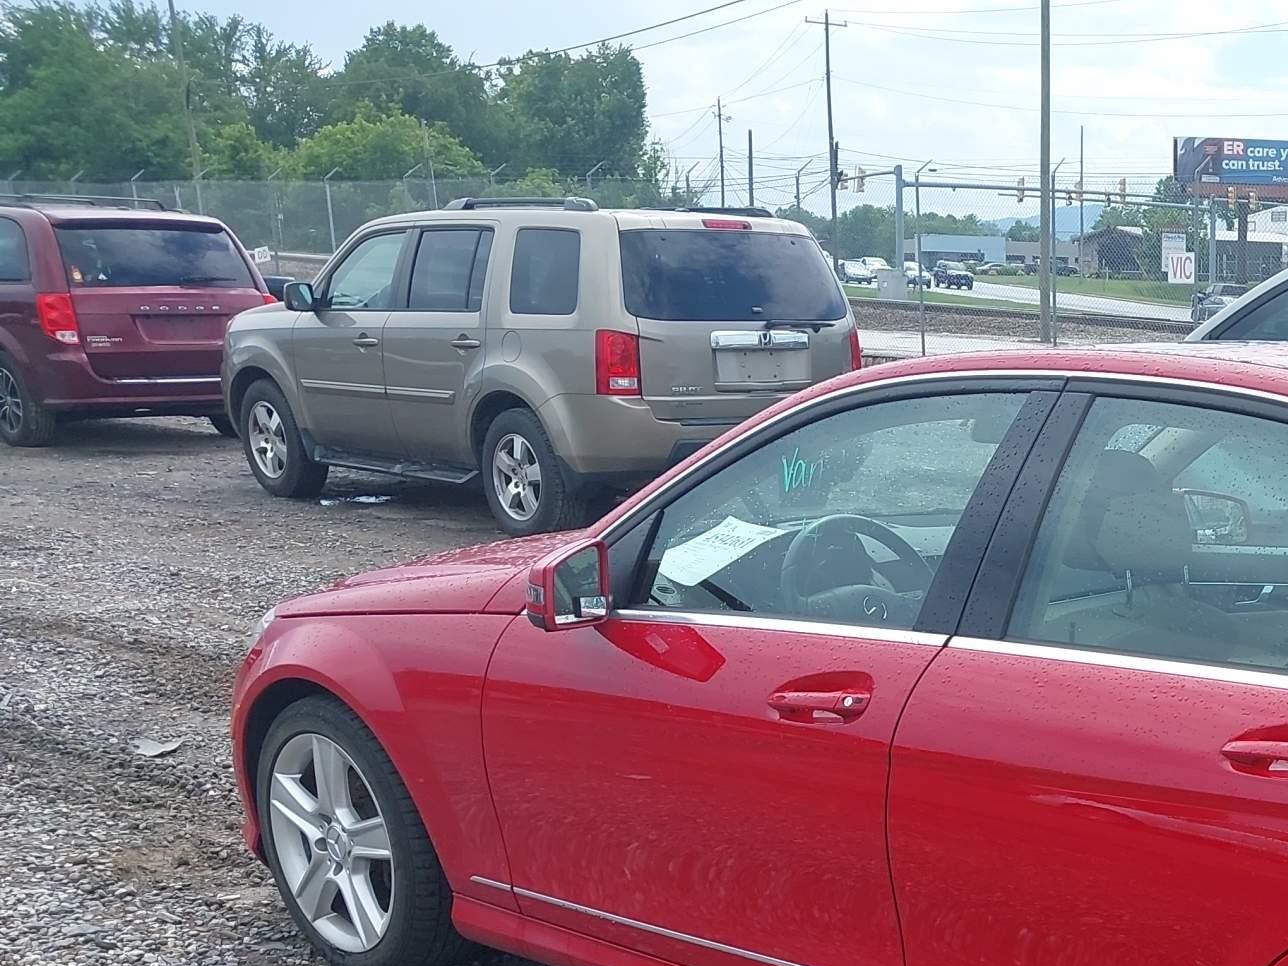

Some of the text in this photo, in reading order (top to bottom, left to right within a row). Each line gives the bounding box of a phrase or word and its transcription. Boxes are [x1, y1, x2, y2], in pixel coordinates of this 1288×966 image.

[1223, 141, 1244, 155] ER
[1247, 147, 1277, 158] care
[1222, 159, 1284, 171] can trust.
[1170, 255, 1193, 280] VIC
